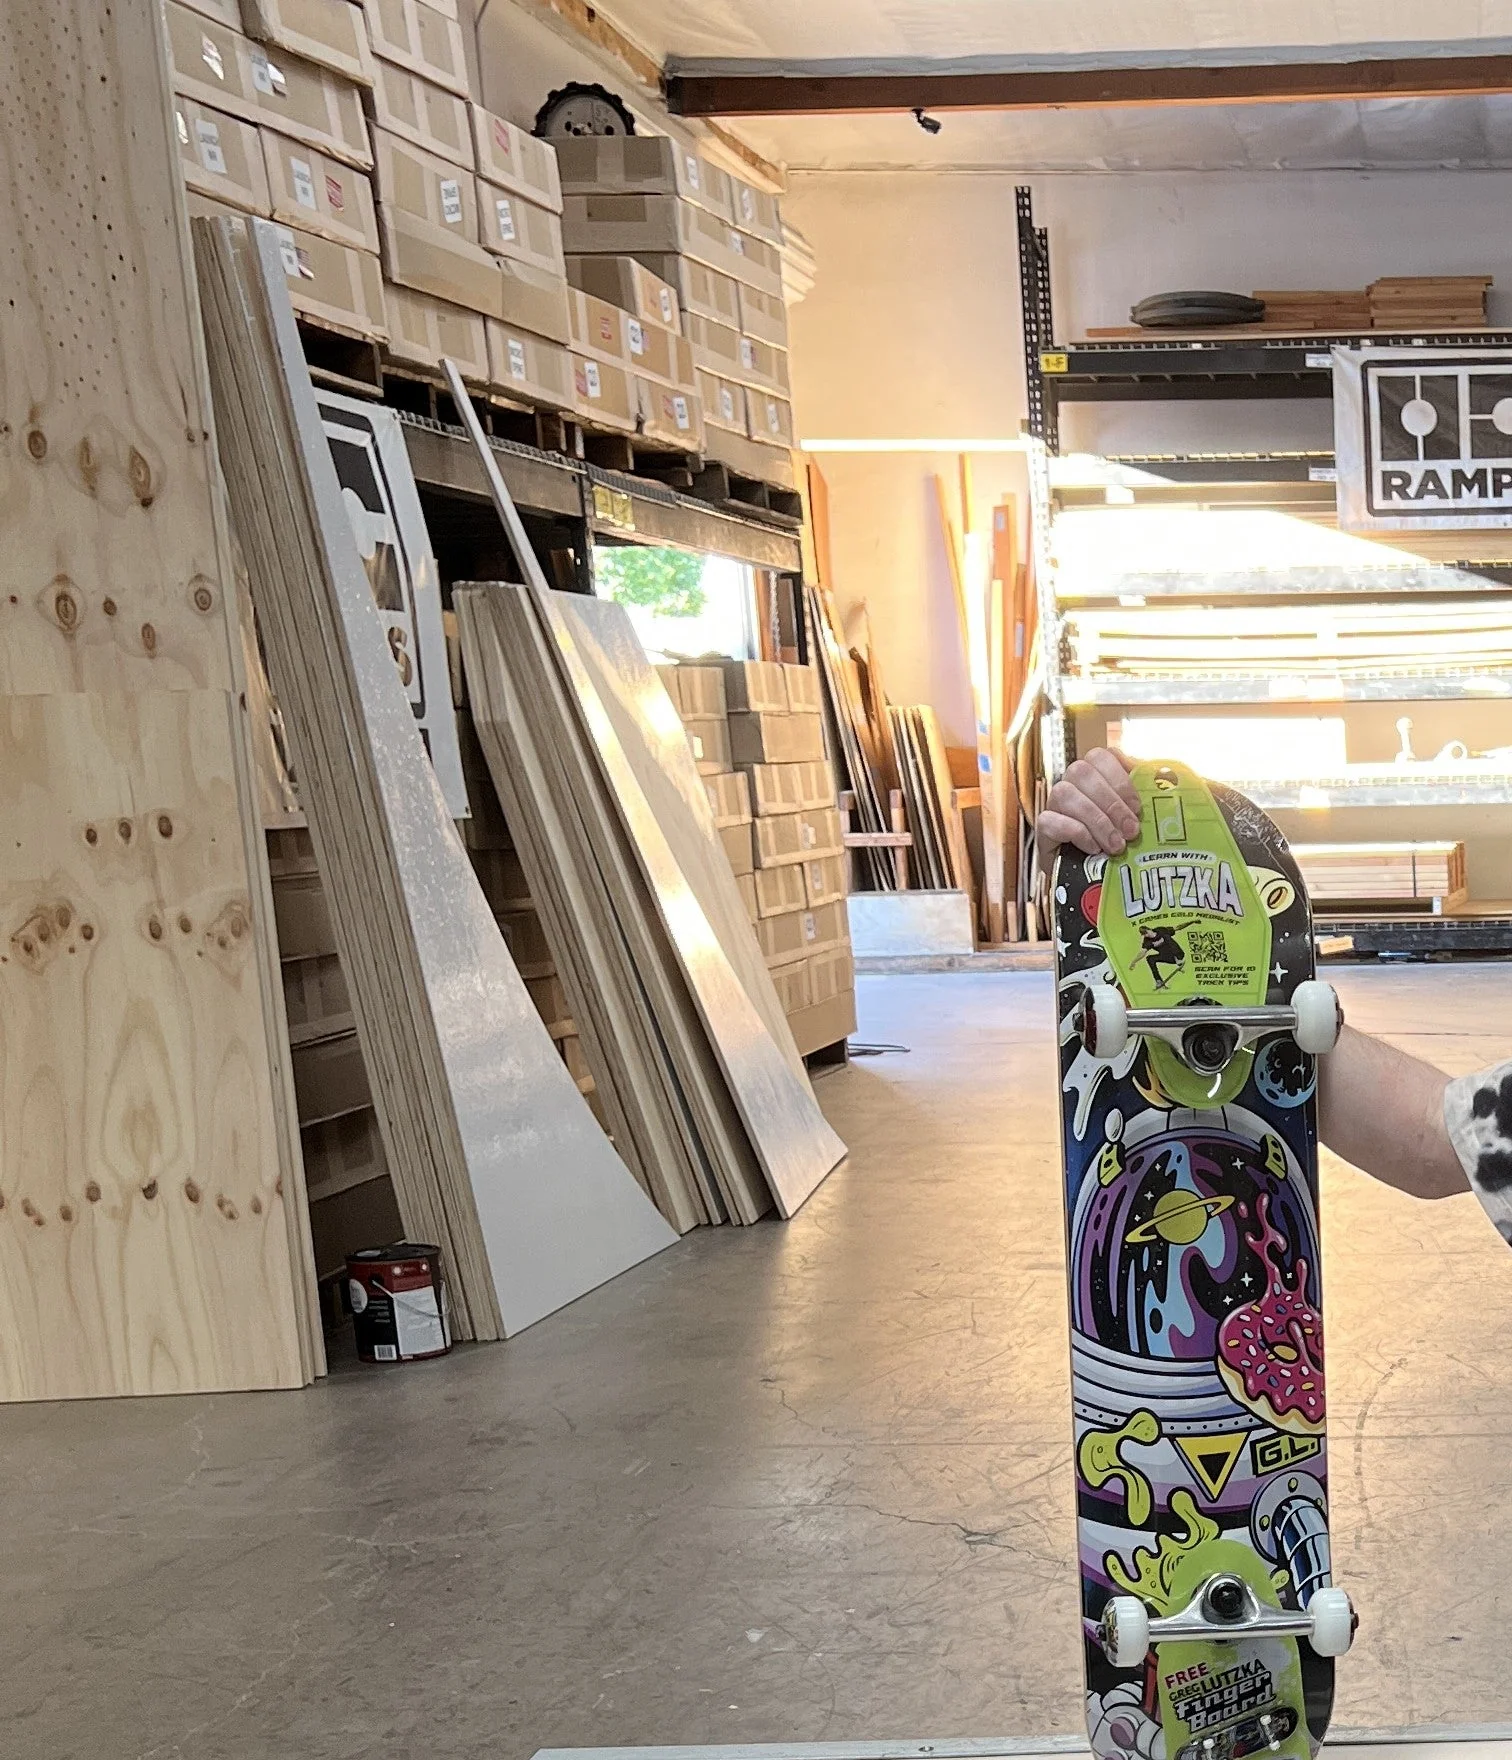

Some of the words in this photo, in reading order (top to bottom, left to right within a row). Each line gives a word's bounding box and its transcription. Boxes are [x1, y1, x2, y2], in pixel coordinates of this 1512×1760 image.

[1142, 851, 1178, 863] LEARN
[1181, 851, 1209, 861] WITH
[1120, 860, 1244, 919] LUTZKA
[1131, 920, 1137, 928] X
[1138, 912, 1169, 925] GAMES
[1195, 911, 1241, 926] MEDALIST
[1164, 1661, 1210, 1690] FREE
[1169, 1682, 1200, 1702] GREG
[1200, 1658, 1267, 1694] LUTZKA
[1187, 1686, 1276, 1733] Board
